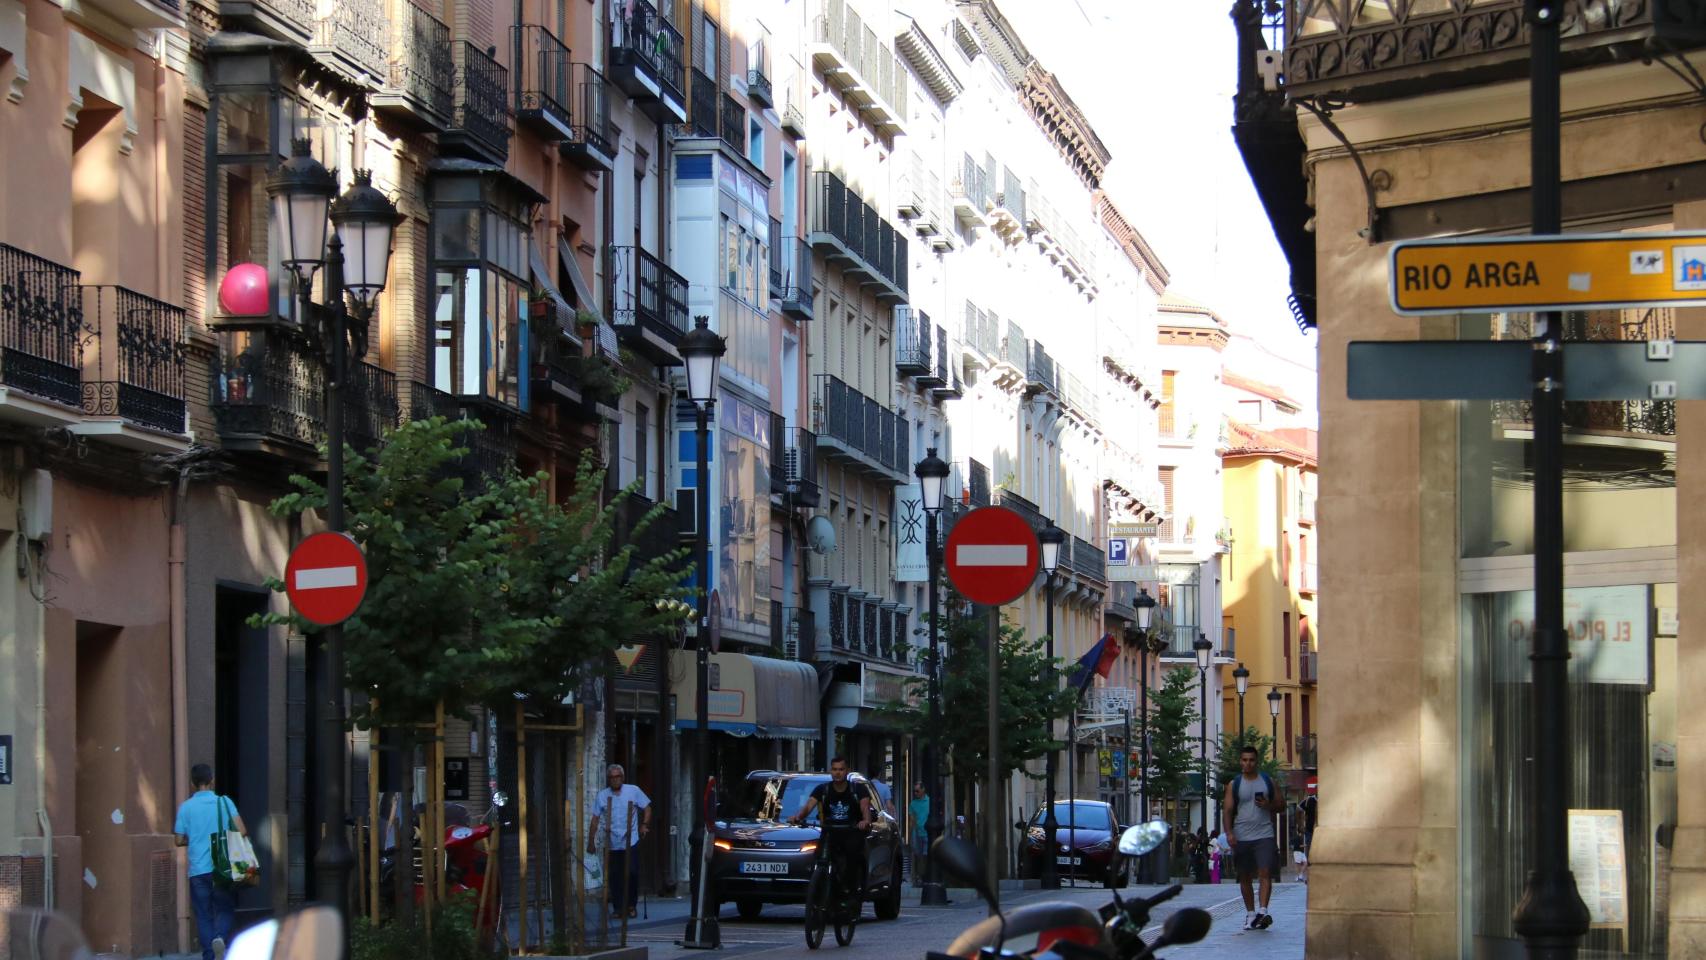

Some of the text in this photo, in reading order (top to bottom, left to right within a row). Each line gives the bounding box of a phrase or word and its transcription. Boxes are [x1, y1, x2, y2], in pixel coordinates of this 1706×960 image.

[1404, 261, 1541, 291] RIO ARGA
[1109, 526, 1154, 534] RESTAURANTE
[1111, 541, 1124, 558] P
[745, 863, 787, 873] 2431 NDX
